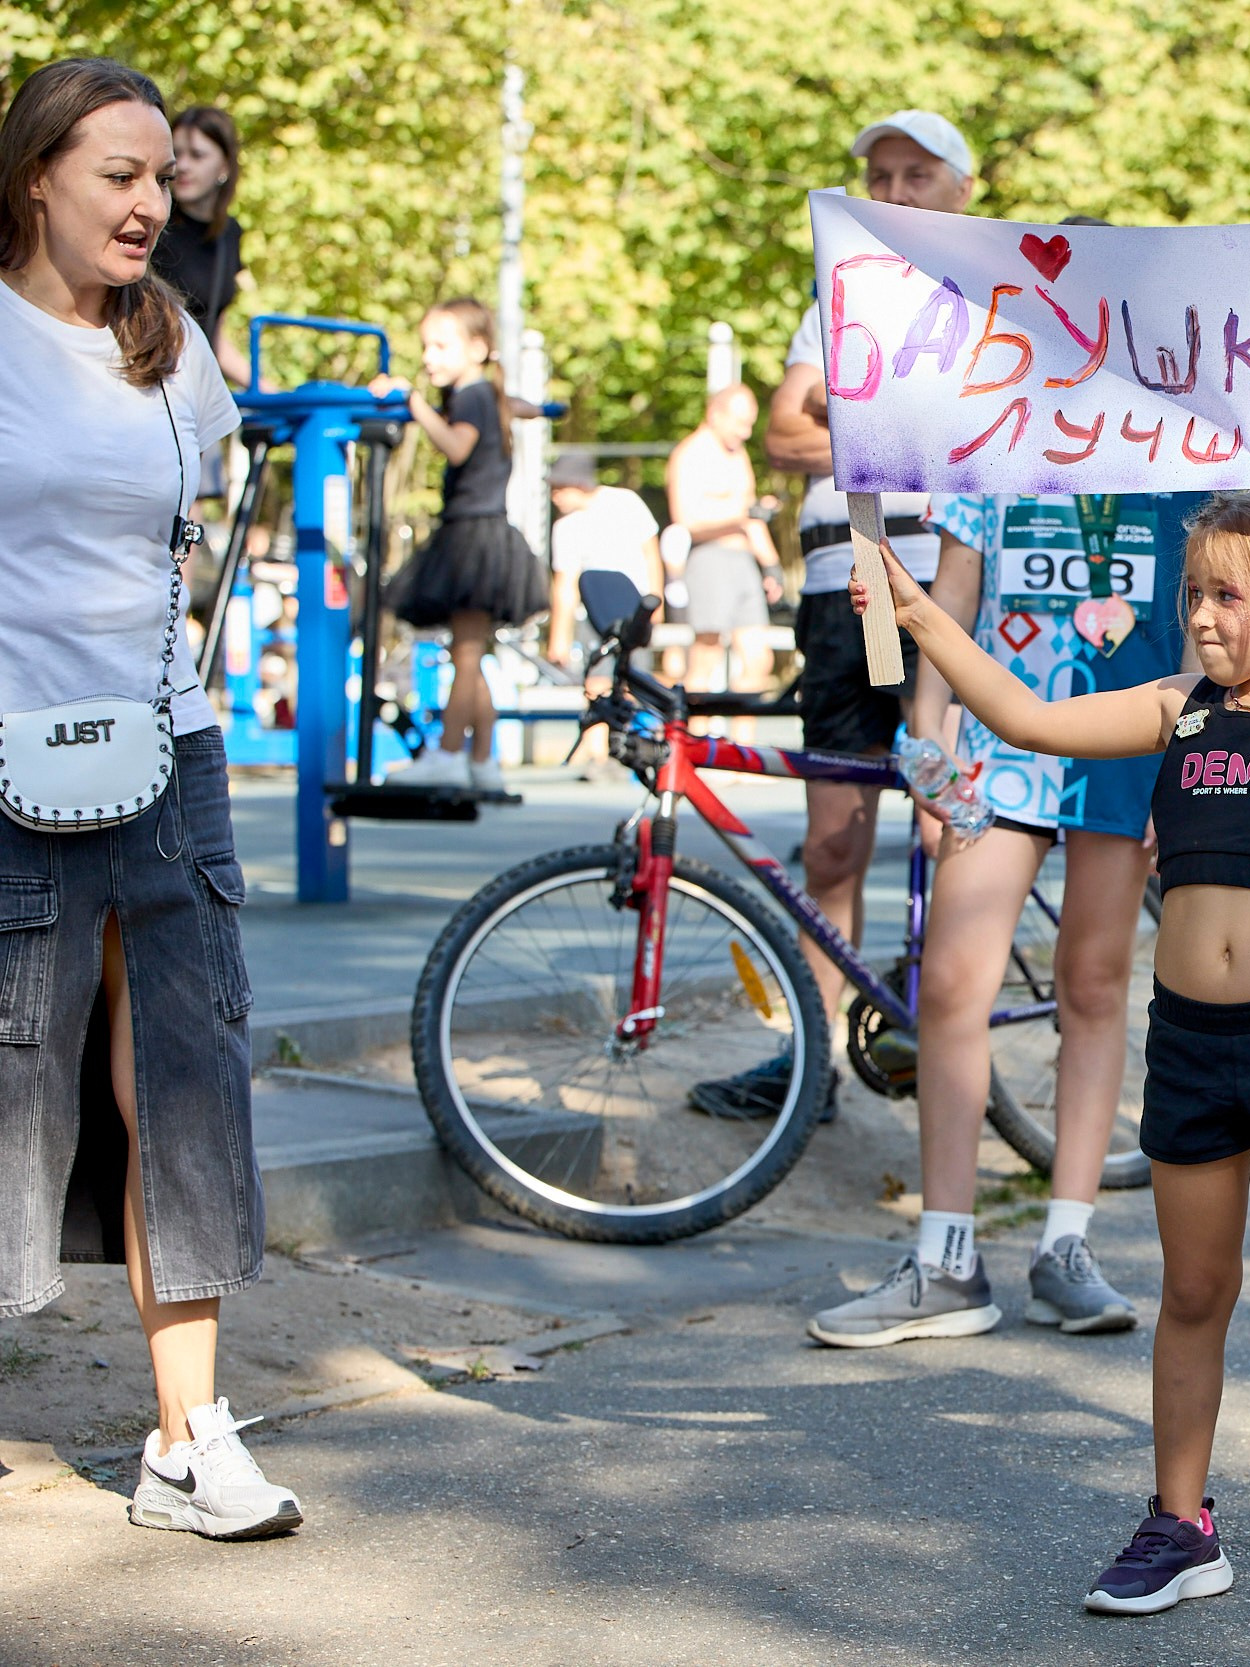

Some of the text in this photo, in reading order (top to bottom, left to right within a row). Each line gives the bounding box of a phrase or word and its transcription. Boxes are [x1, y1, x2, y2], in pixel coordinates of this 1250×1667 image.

[45, 718, 116, 747] JUST
[1192, 787, 1214, 796] SPORT
[1214, 787, 1222, 795] IS
[1222, 787, 1248, 795] WHERE
